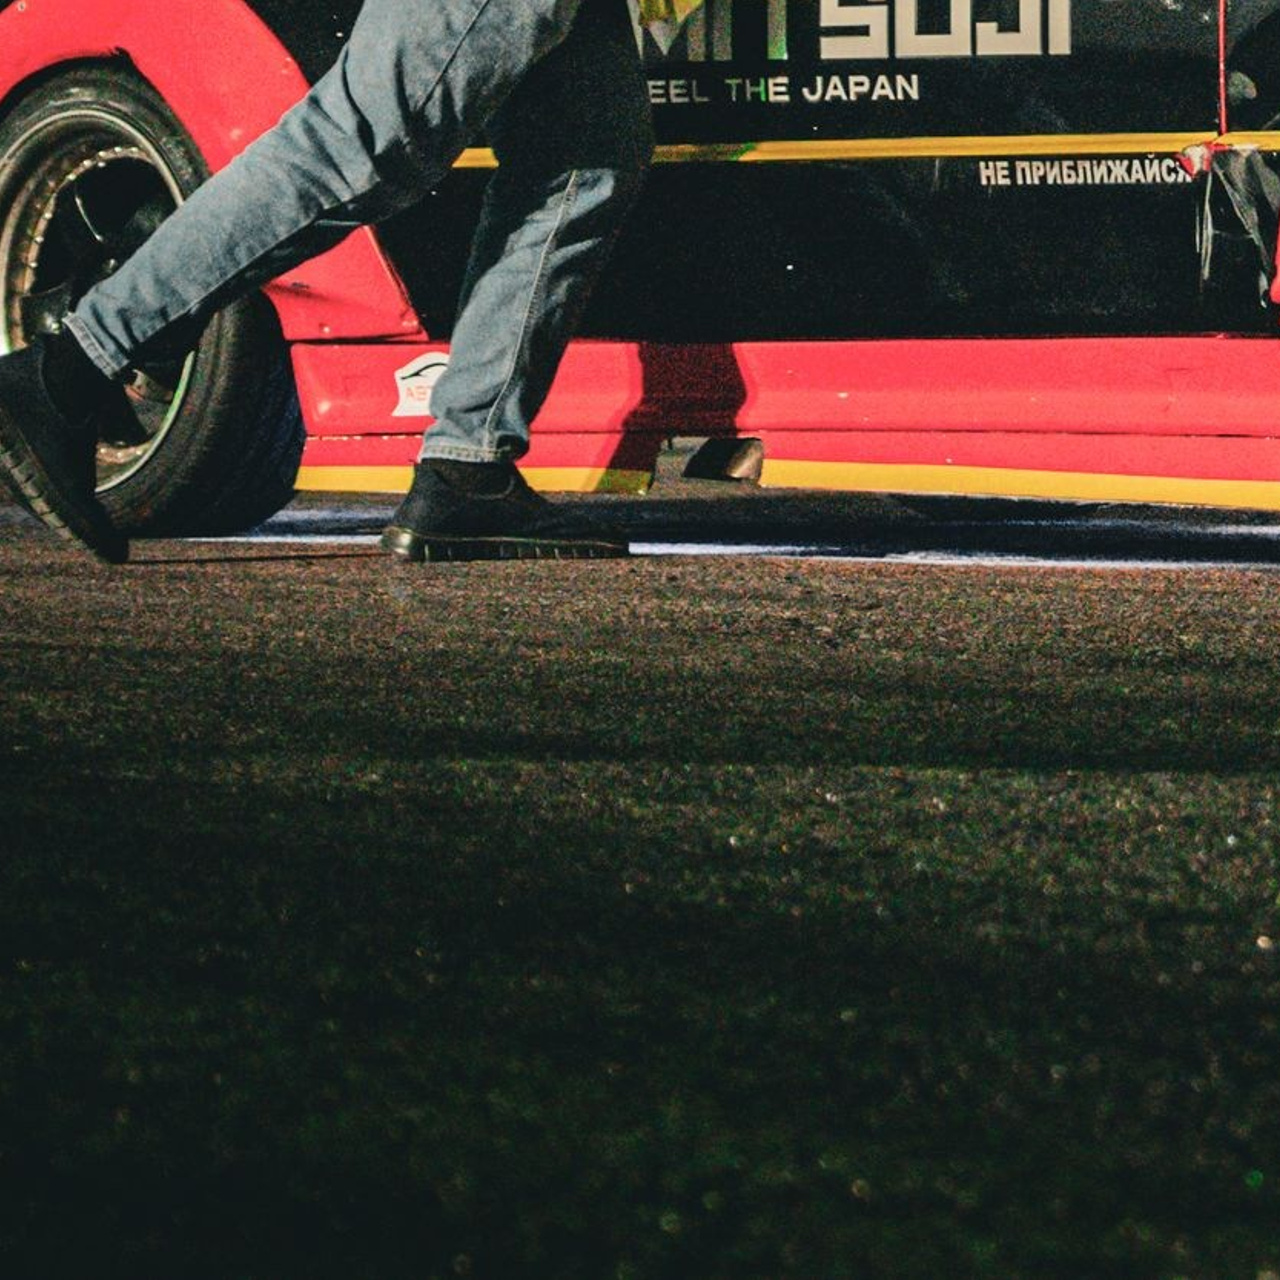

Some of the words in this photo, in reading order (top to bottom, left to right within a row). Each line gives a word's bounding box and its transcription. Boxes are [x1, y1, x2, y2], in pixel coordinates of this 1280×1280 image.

[648, 80, 710, 104] EEL
[724, 76, 790, 103] THE
[802, 74, 920, 102] JAPAN
[979, 160, 1011, 185] НЕ
